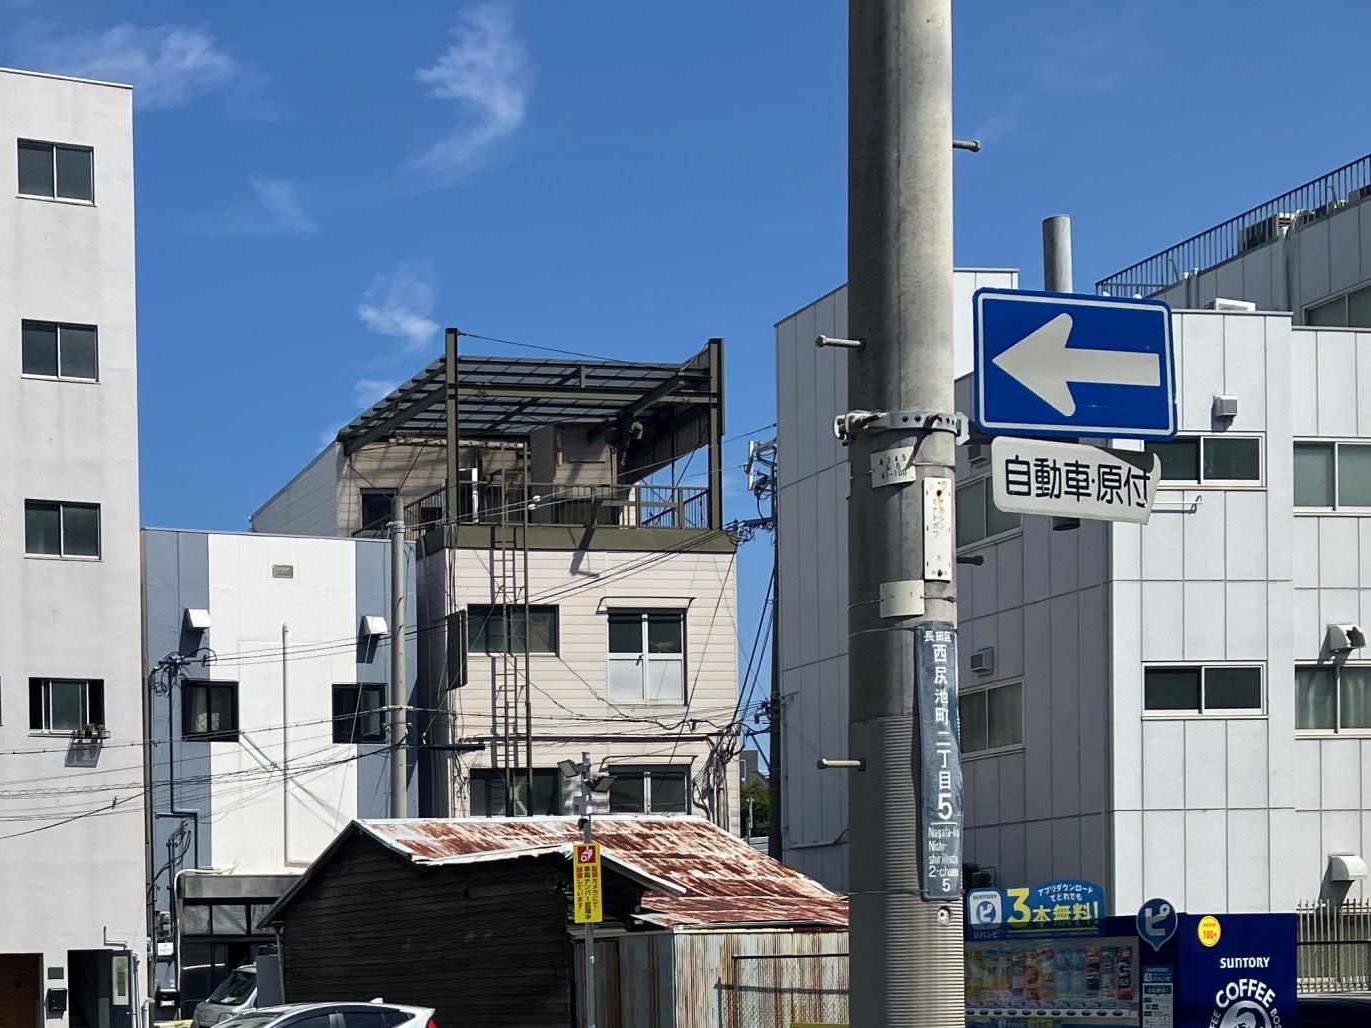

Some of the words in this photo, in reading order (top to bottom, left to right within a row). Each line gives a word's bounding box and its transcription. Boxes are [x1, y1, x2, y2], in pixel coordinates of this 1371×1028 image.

[1005, 454, 1150, 508] 自動車・原付
[924, 630, 951, 643] 長田区
[942, 878, 951, 892] 5
[1037, 883, 1094, 897] アプリダウンロード
[1145, 903, 1171, 936] ピ
[973, 930, 1000, 938] ジハンピ
[1216, 978, 1276, 1008] COFFEE
